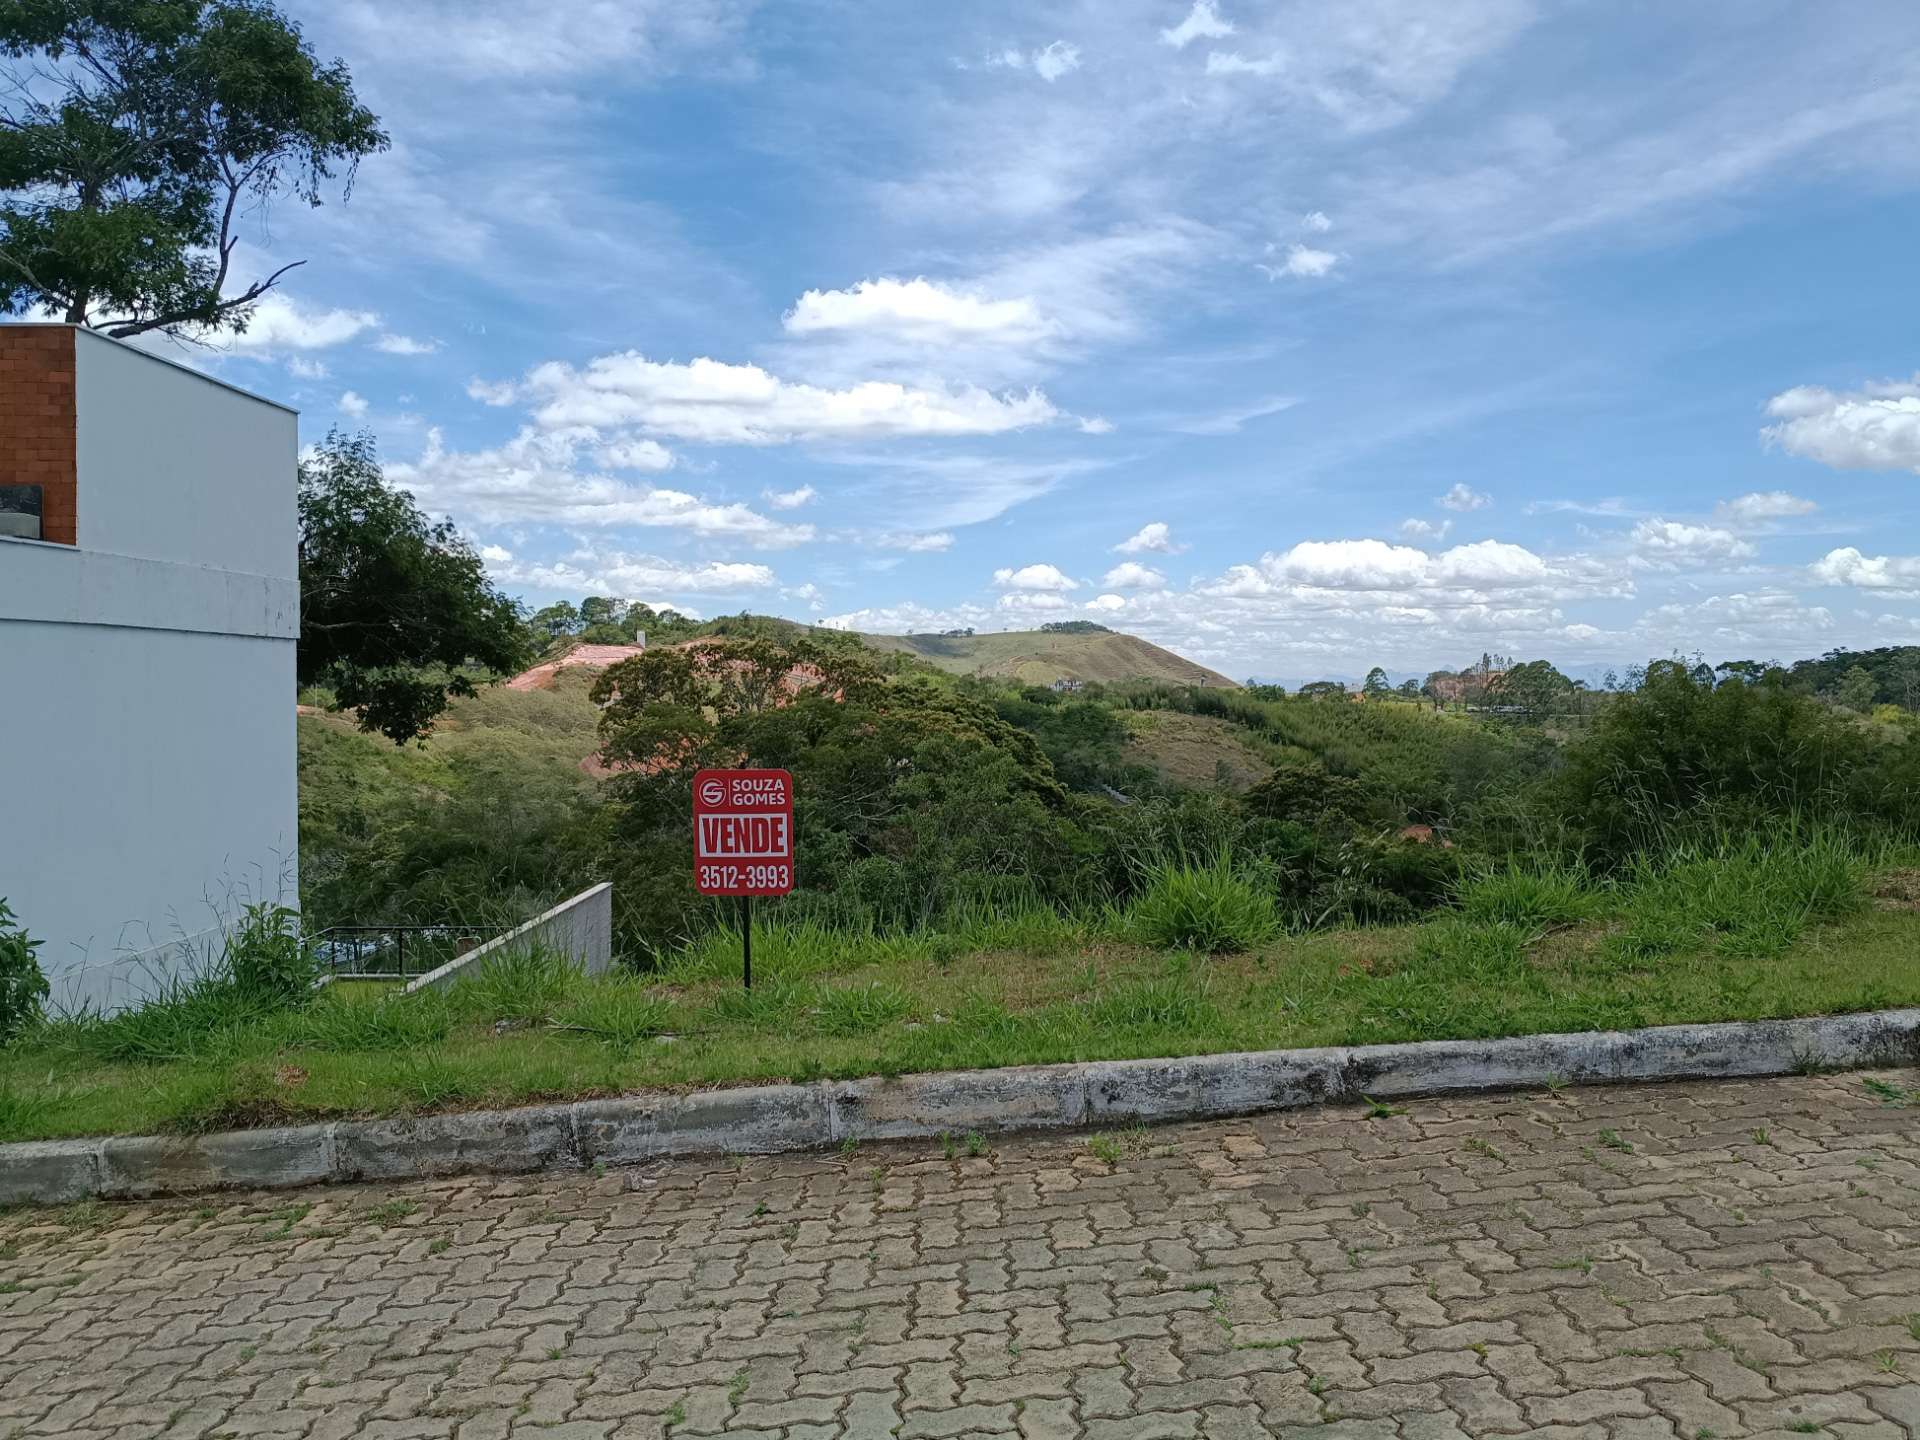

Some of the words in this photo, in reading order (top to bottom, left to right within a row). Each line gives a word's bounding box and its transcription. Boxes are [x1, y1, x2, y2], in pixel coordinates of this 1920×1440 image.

[732, 779, 785, 791] SOUZA
[732, 793, 786, 805] GOMES
[702, 817, 785, 853] VENDE
[700, 865, 789, 888] 3512-3993
